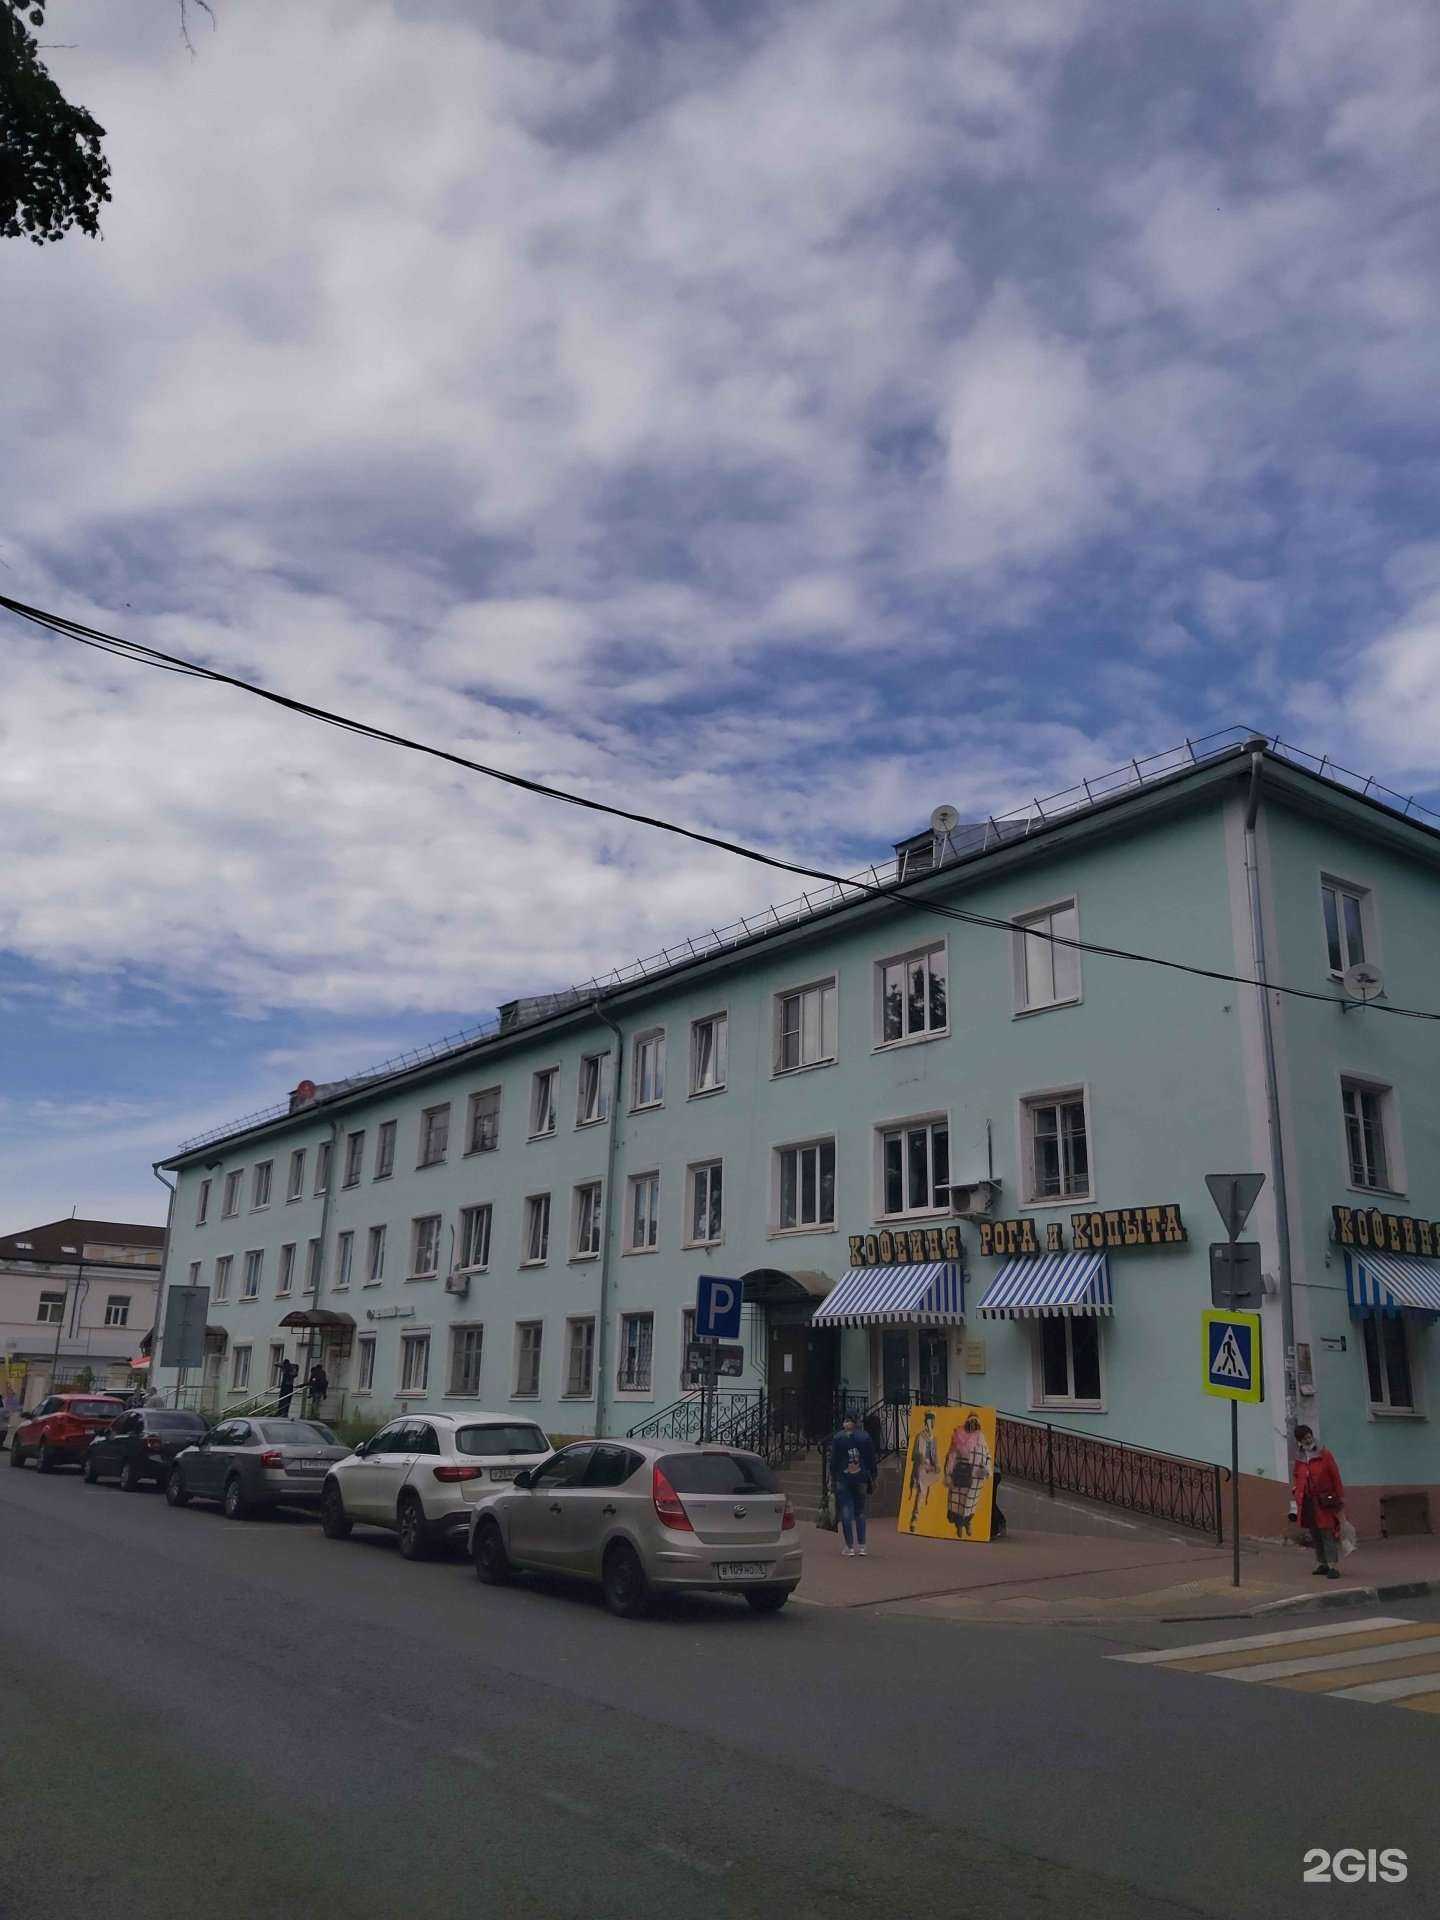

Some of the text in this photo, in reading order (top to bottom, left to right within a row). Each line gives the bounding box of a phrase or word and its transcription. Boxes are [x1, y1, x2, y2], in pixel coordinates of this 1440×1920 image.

[849, 1226, 961, 1267] КОФЕЙНЯ
[980, 1218, 1036, 1256] РОГА
[1071, 1204, 1185, 1249] КОПЫТА
